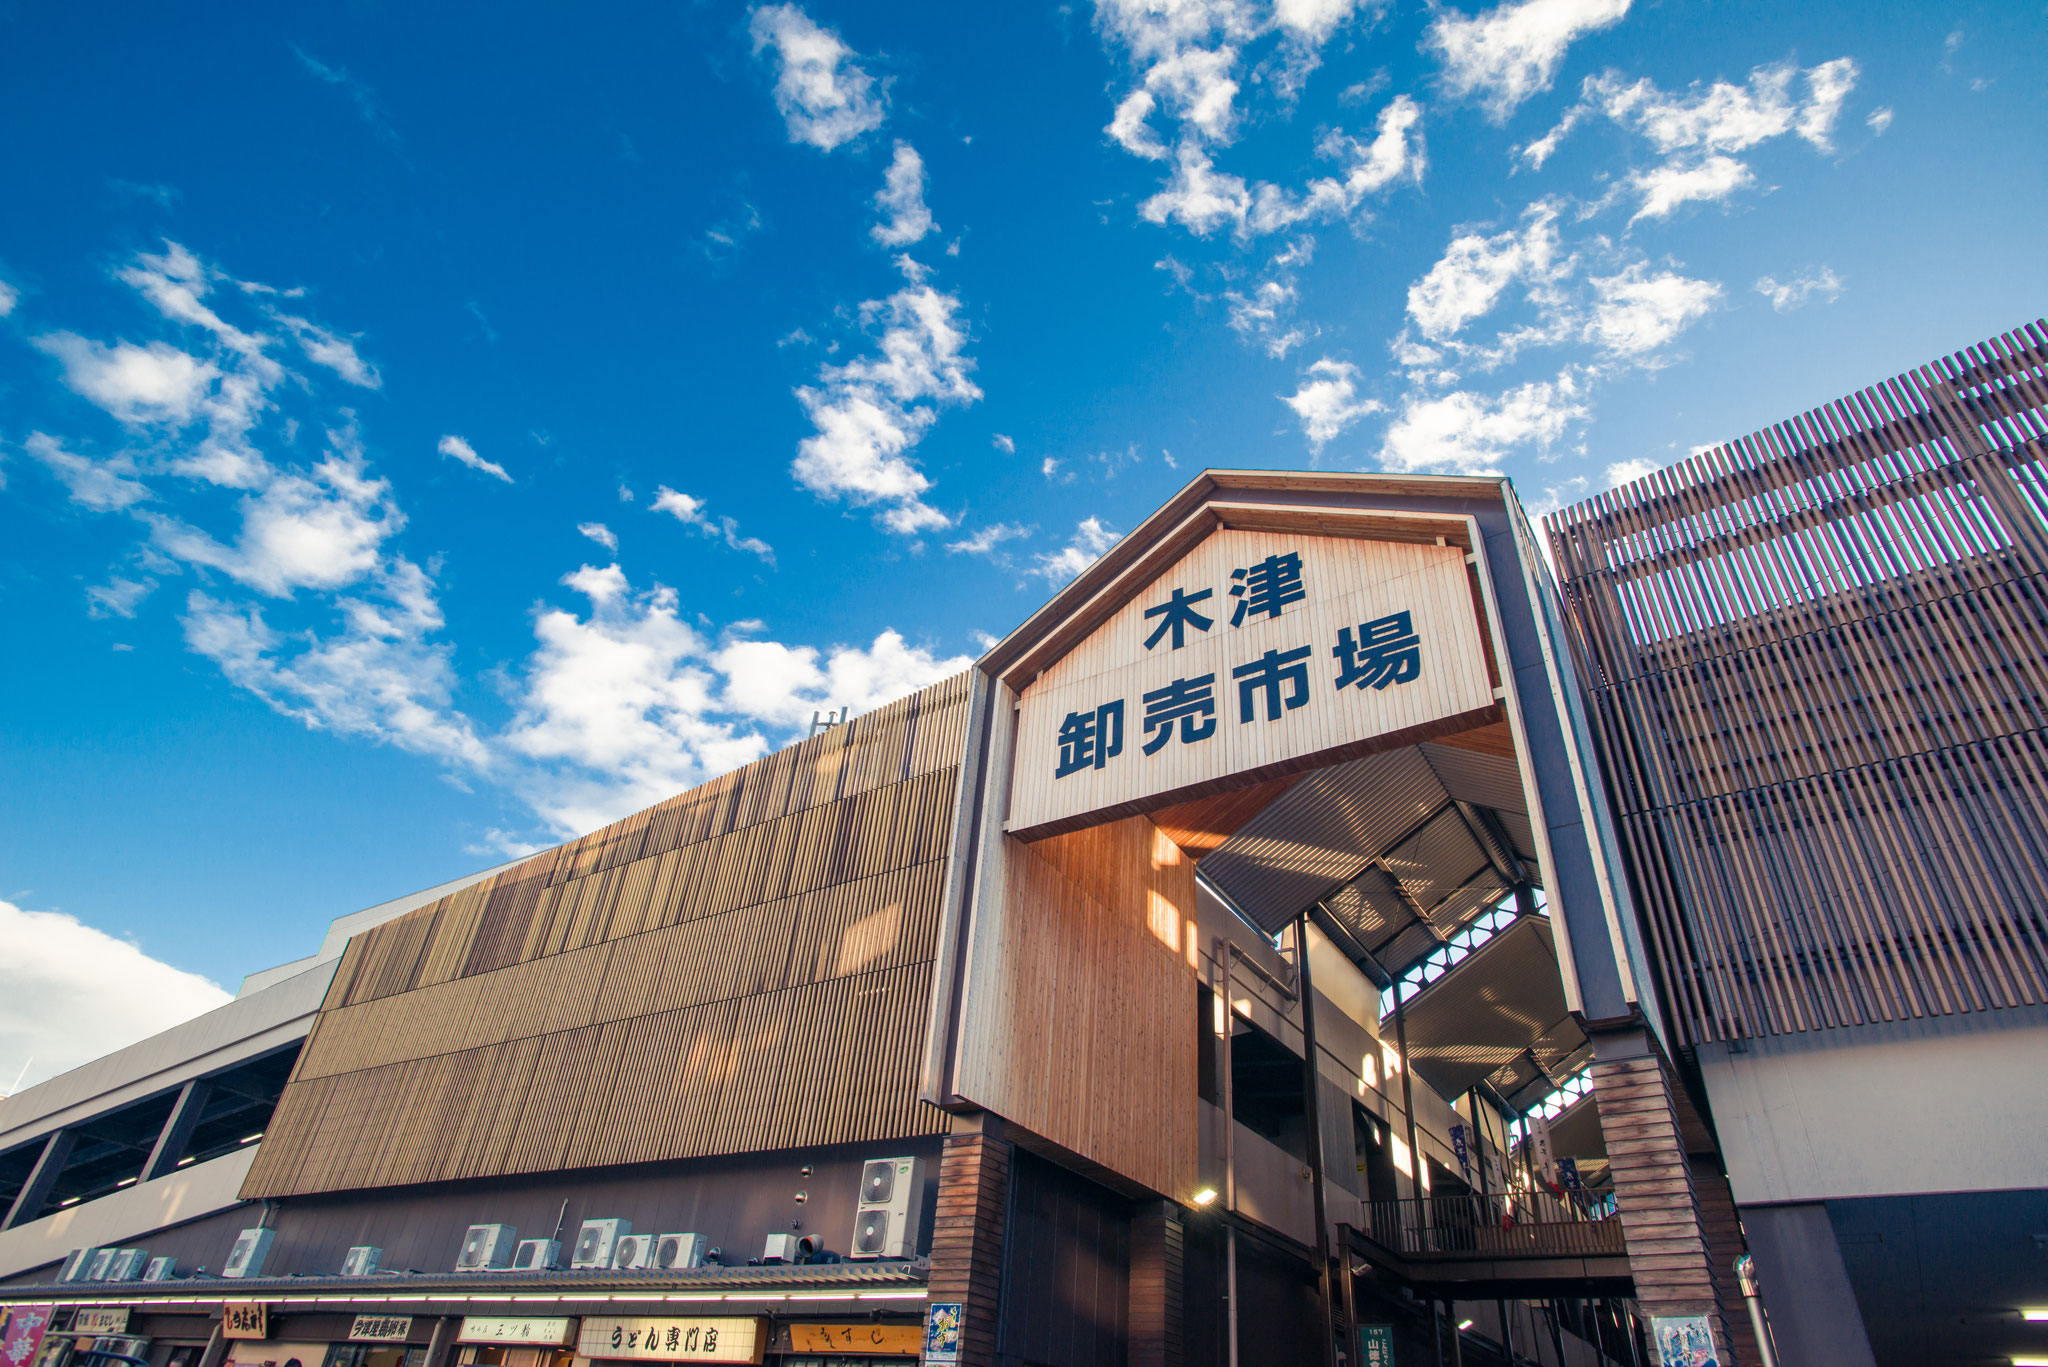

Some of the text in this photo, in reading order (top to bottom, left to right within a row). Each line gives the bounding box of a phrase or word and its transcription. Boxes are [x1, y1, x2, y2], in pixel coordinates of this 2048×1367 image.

[1143, 551, 1306, 651] 木津
[1055, 610, 1421, 780] 卸売市場
[6, 1312, 44, 1365] 中華
[611, 1325, 718, 1352] うどん専門店
[1369, 1328, 1383, 1336] 157
